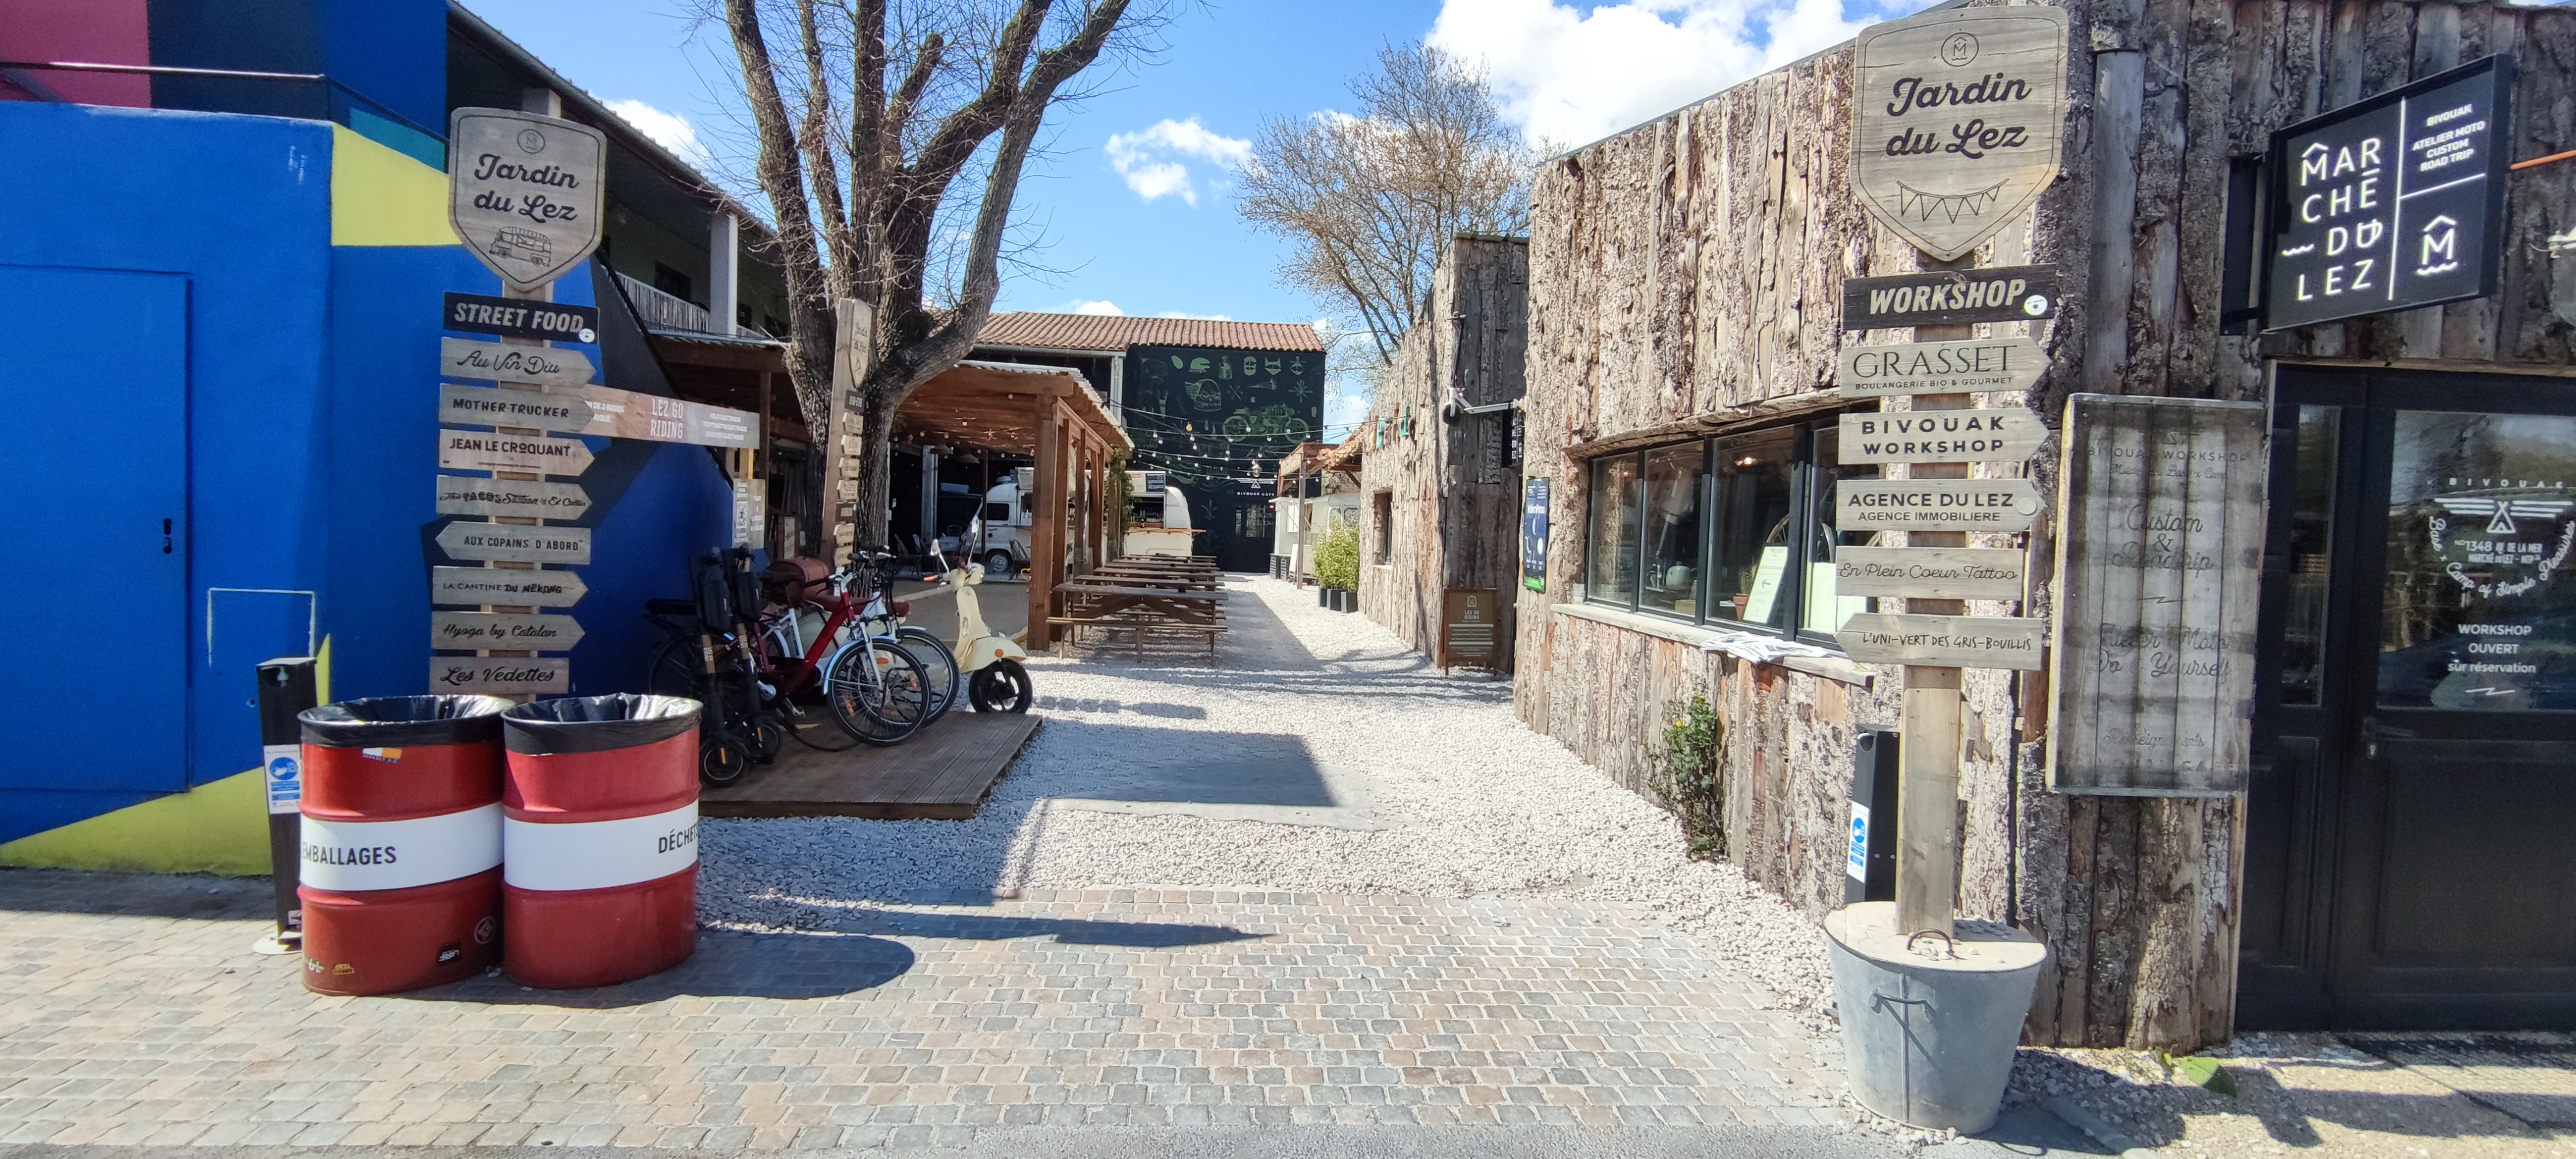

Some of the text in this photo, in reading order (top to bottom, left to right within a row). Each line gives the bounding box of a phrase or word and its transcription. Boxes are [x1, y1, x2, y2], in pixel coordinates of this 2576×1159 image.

[1887, 72, 2032, 117] Jardin
[2426, 103, 2473, 126] BIVOUAK
[1886, 119, 2029, 159] du Lez
[2411, 120, 2486, 151] ATELIER MOTO
[2426, 137, 2469, 158] CUSTOM
[2420, 148, 2474, 172] ROAD TRIP
[474, 153, 580, 189] Jardin
[473, 189, 578, 224] du Lez
[2327, 219, 2383, 256] DU
[2297, 258, 2374, 301] LEZ
[1869, 279, 2027, 315] WORKSHOP
[454, 302, 585, 334] STREET FOOD
[456, 350, 490, 368] Au
[493, 351, 522, 371] Vin
[1853, 344, 2018, 378] GRASSET
[1855, 380, 1926, 390] BOULANGERIE
[1929, 379, 1947, 388] BIO
[1960, 376, 2013, 386] GOURMET
[453, 398, 507, 413] MOTHER
[510, 402, 569, 418] TRUCKER
[651, 398, 684, 419] LEZ GO
[650, 419, 684, 439] RIDING
[1862, 416, 2004, 435] BIVOUAK
[450, 438, 481, 451] JEAN
[485, 441, 498, 451] LE
[1863, 440, 2003, 455] WORKSHOP
[2448, 477, 2564, 489] BIVOUAK
[502, 493, 539, 505] Station
[1848, 493, 2014, 507] AGENCE DU LEZ
[1858, 512, 2001, 522] AGENCE IMMOBILIERE
[464, 536, 484, 546] AUX
[487, 538, 529, 549] COPAINS
[2154, 533, 2174, 553] &
[1840, 563, 2017, 580] En Plein Coeur Tattoo
[504, 584, 518, 593] DU
[443, 623, 558, 639] Hyoga by Catalan
[2458, 623, 2532, 636] WORKSHOP
[1863, 633, 2031, 651] L'UNI-VERT DES GRIS-BOUILLIS
[2468, 643, 2520, 654] OUVERT
[440, 666, 555, 686] Les Vedettes
[2448, 661, 2536, 673] sur réservation
[302, 842, 398, 865] EMBALLAGES
